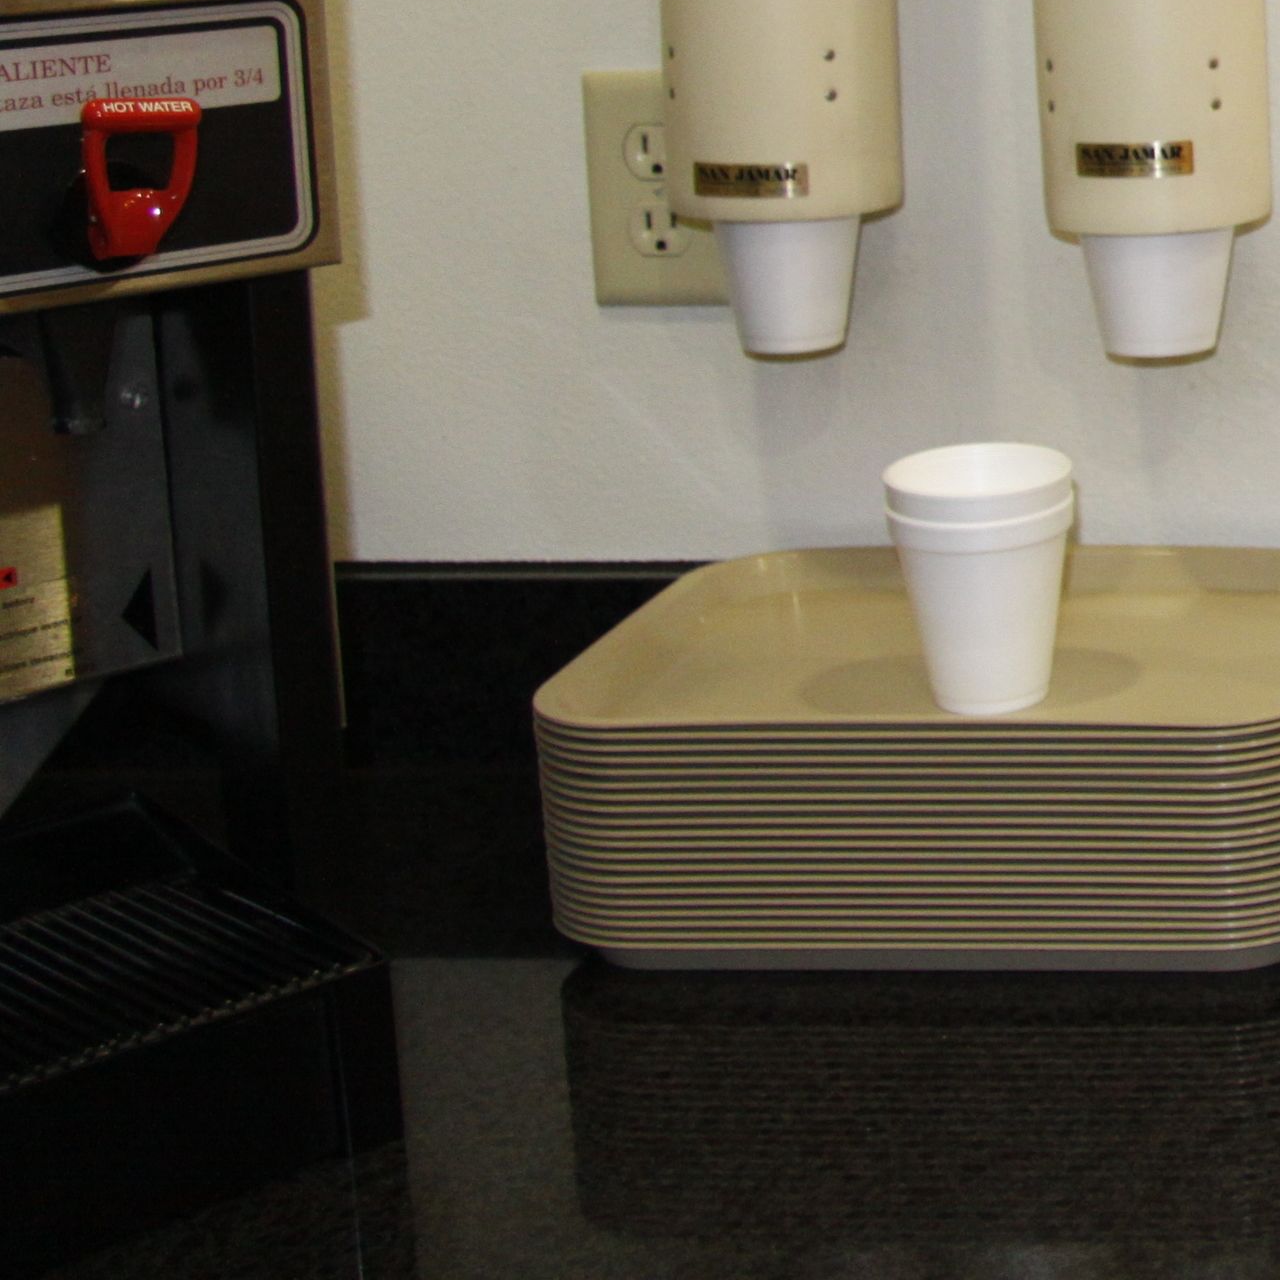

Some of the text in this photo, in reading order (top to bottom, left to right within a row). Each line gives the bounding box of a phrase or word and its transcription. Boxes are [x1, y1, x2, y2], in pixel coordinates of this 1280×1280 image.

[105, 76, 187, 99] llenada
[193, 75, 228, 97] por
[234, 67, 264, 86] 3/4
[102, 101, 194, 114] HOT WATER
